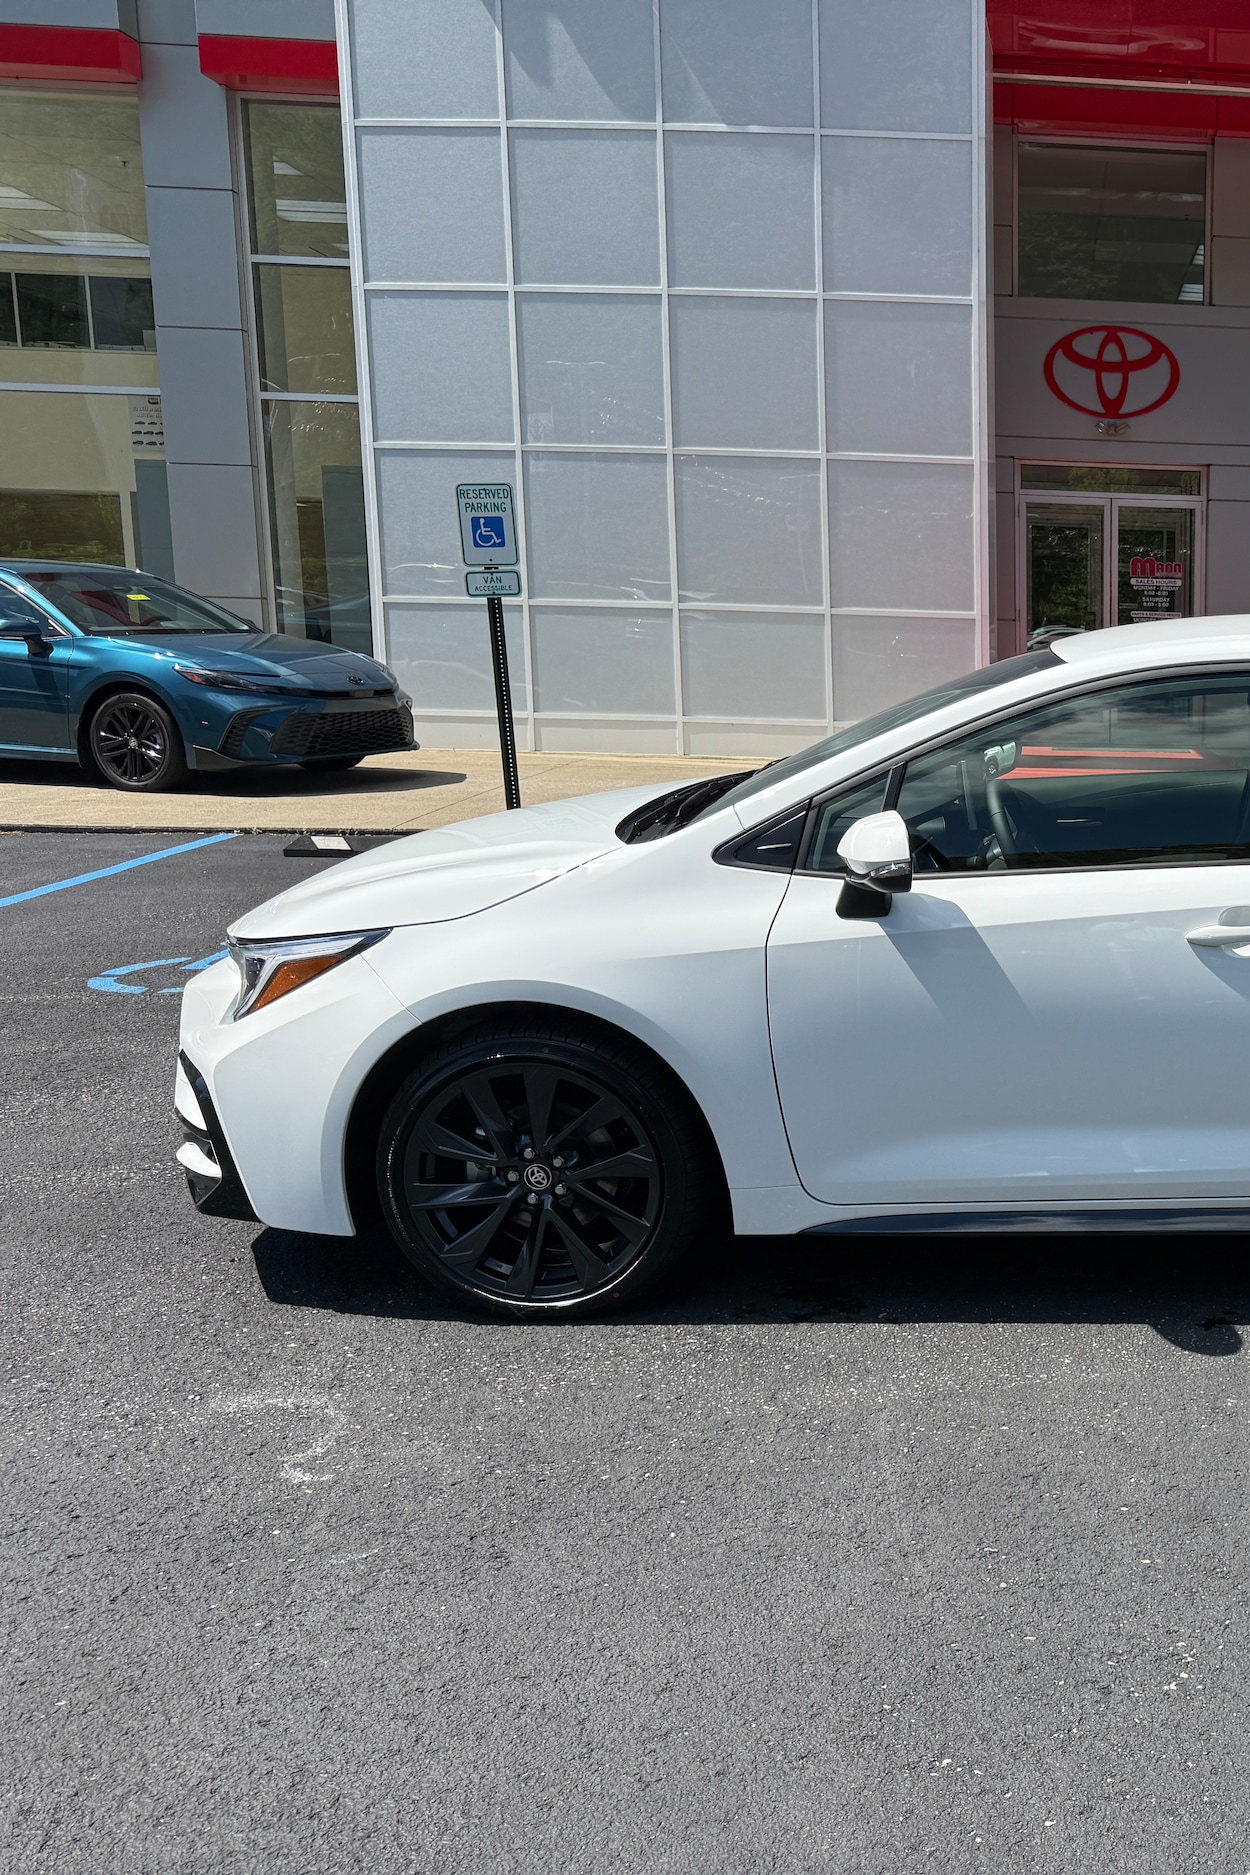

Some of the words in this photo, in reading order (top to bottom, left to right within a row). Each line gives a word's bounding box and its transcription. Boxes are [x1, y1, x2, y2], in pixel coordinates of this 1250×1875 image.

[459, 488, 509, 500] RESERVED
[465, 502, 507, 513] PARKING
[482, 576, 502, 584] VAN
